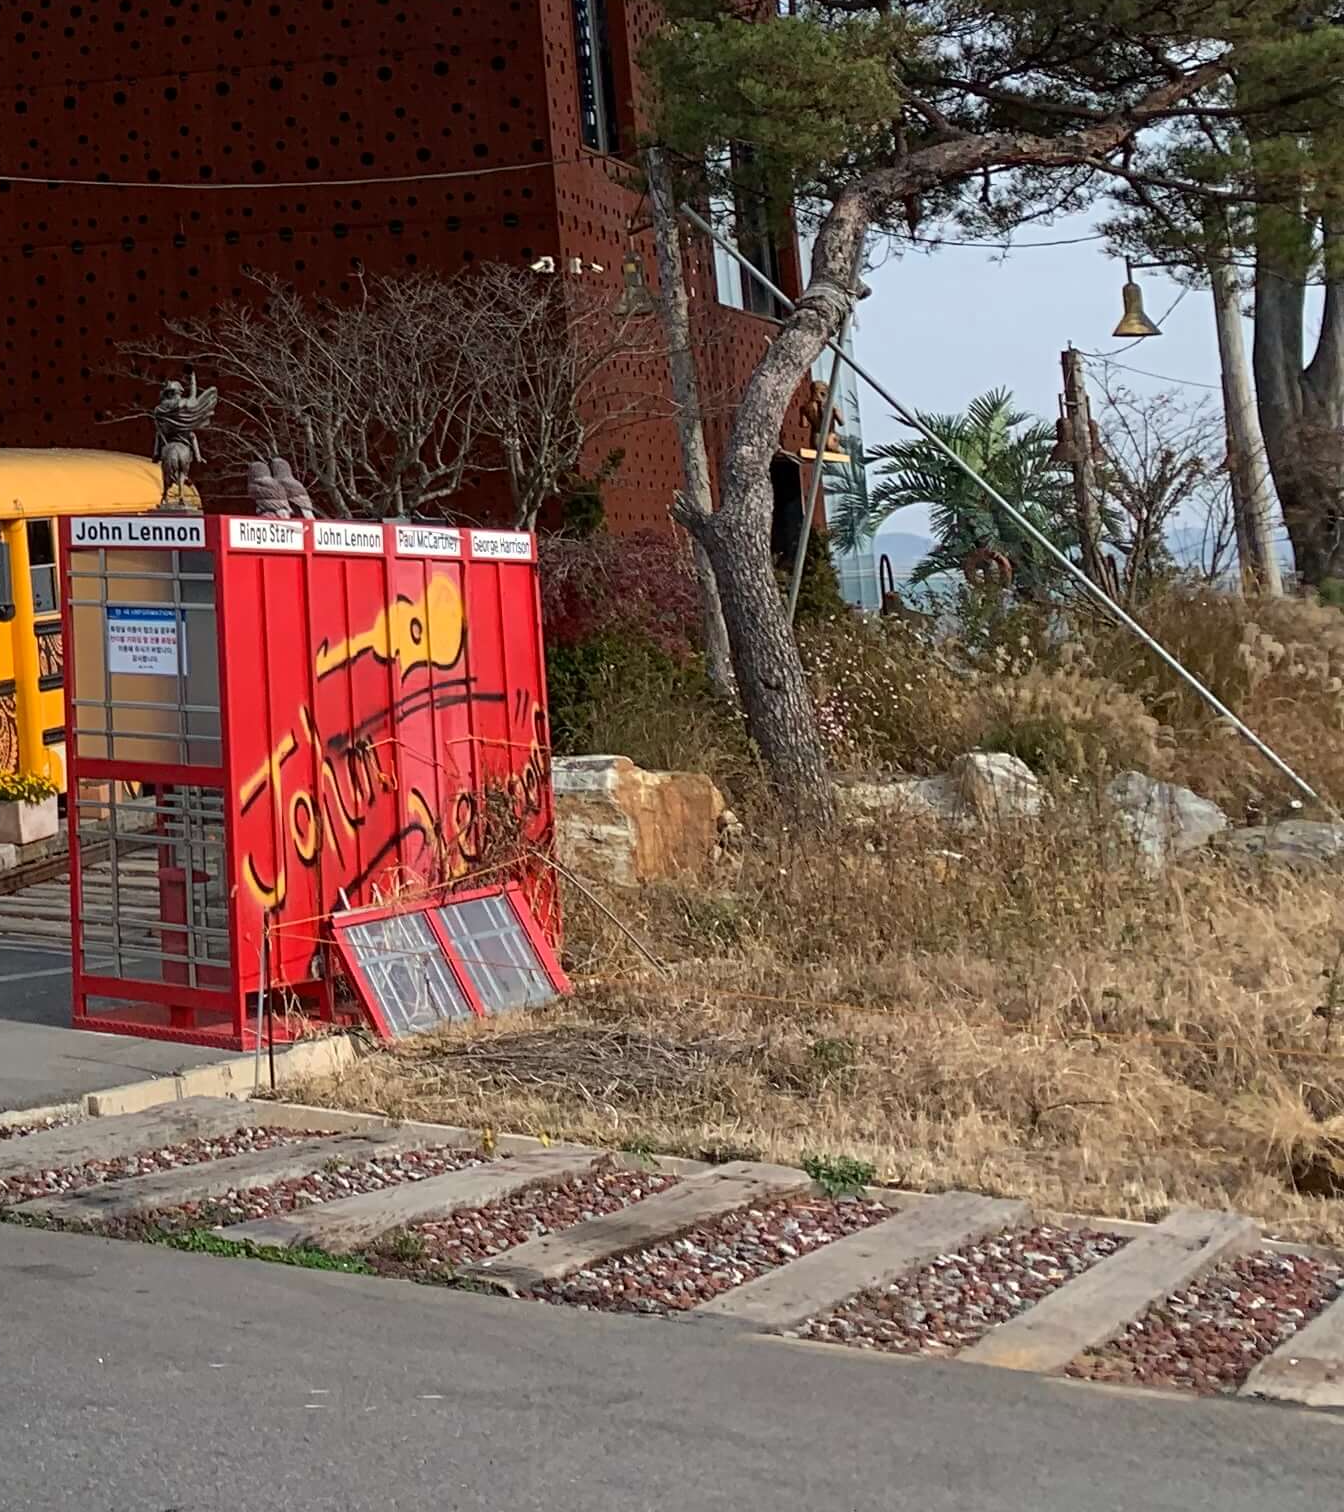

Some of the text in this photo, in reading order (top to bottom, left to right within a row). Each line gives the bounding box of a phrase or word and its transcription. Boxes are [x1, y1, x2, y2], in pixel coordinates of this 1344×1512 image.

[76, 522, 201, 541] John Lennon
[240, 522, 294, 544] Ringo Starr
[317, 528, 381, 548] John Lennon
[399, 530, 457, 552] Paul McCartney
[473, 536, 530, 554] George Harrison
